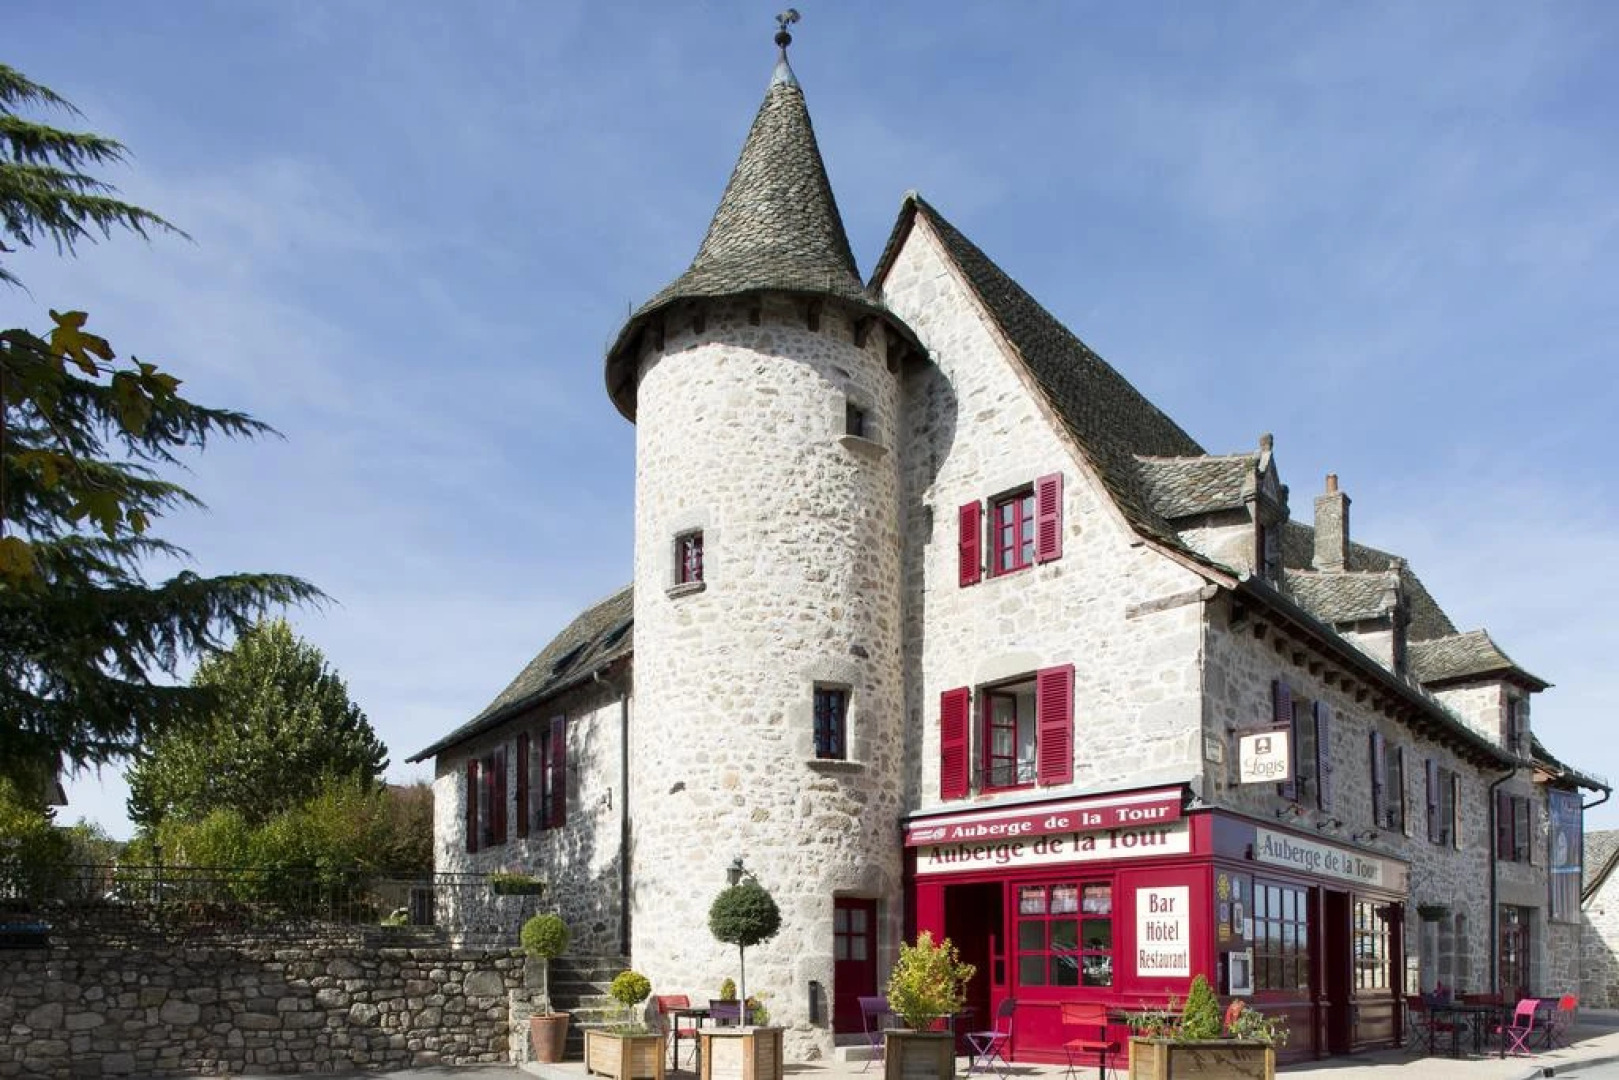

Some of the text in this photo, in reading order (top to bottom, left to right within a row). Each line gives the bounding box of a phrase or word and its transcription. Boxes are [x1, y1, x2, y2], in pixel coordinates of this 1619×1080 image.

[1244, 757, 1285, 778] Logis
[951, 805, 1170, 838] Auberge de la Tour
[929, 827, 1171, 864] Auberge de la Tour
[1263, 835, 1378, 878] Auberge de la Tour
[1149, 893, 1176, 913] Bar
[1139, 948, 1188, 969] Restaurant
